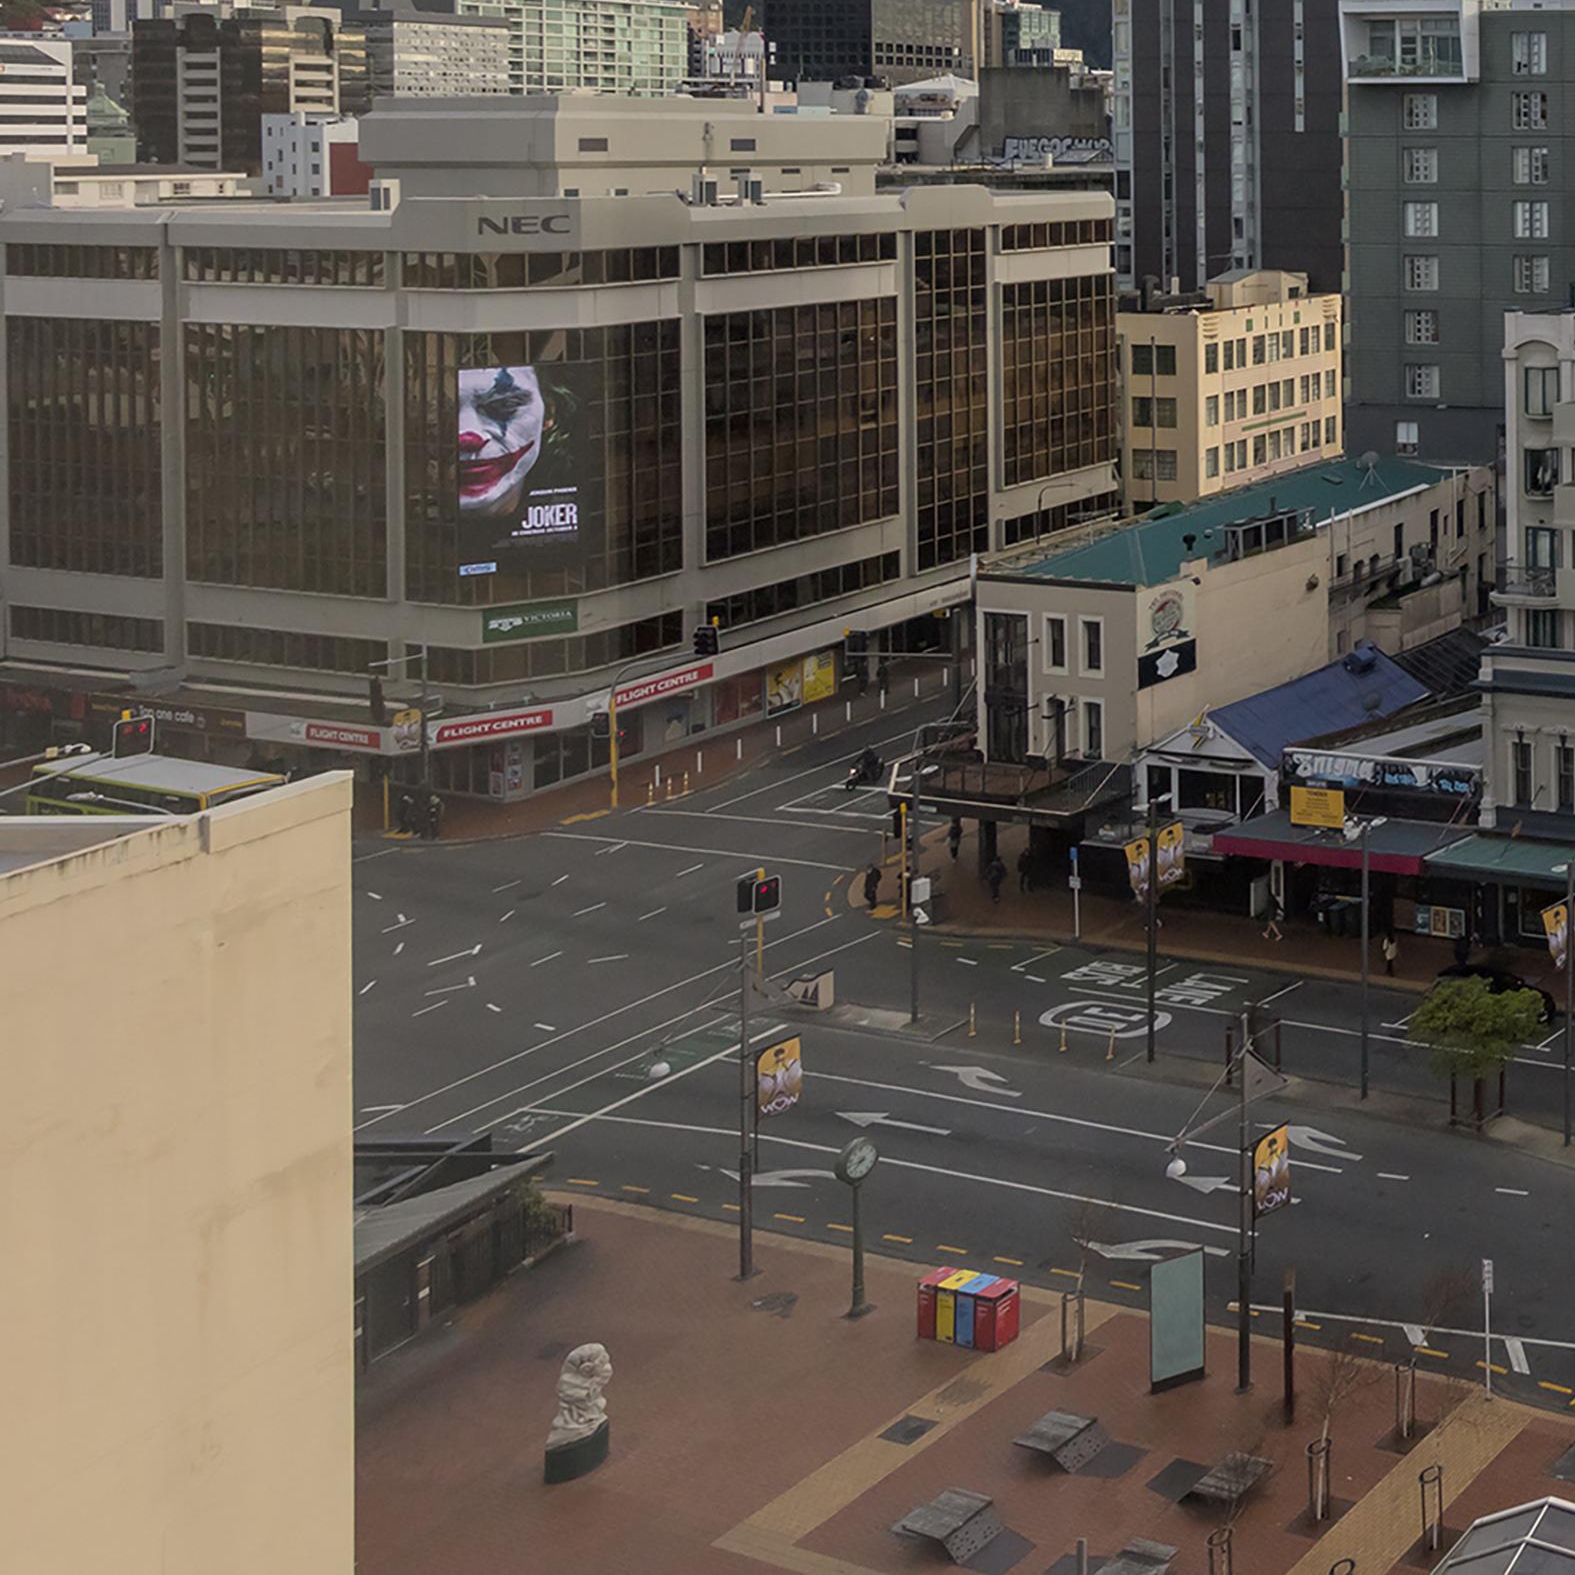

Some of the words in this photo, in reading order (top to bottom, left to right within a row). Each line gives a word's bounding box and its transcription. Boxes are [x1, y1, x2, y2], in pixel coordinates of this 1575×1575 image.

[478, 215, 570, 235] NEC
[522, 503, 578, 529] JOKER
[524, 610, 573, 623] VICTORIA
[617, 683, 656, 705] FLIGHT
[657, 670, 699, 692] CENTRE
[155, 708, 174, 722] one
[174, 711, 195, 724] cafe
[309, 728, 338, 741] FLIGHT
[339, 731, 369, 745] CENTRE
[443, 722, 491, 739] FLIGHT
[492, 715, 543, 731] CENTRE
